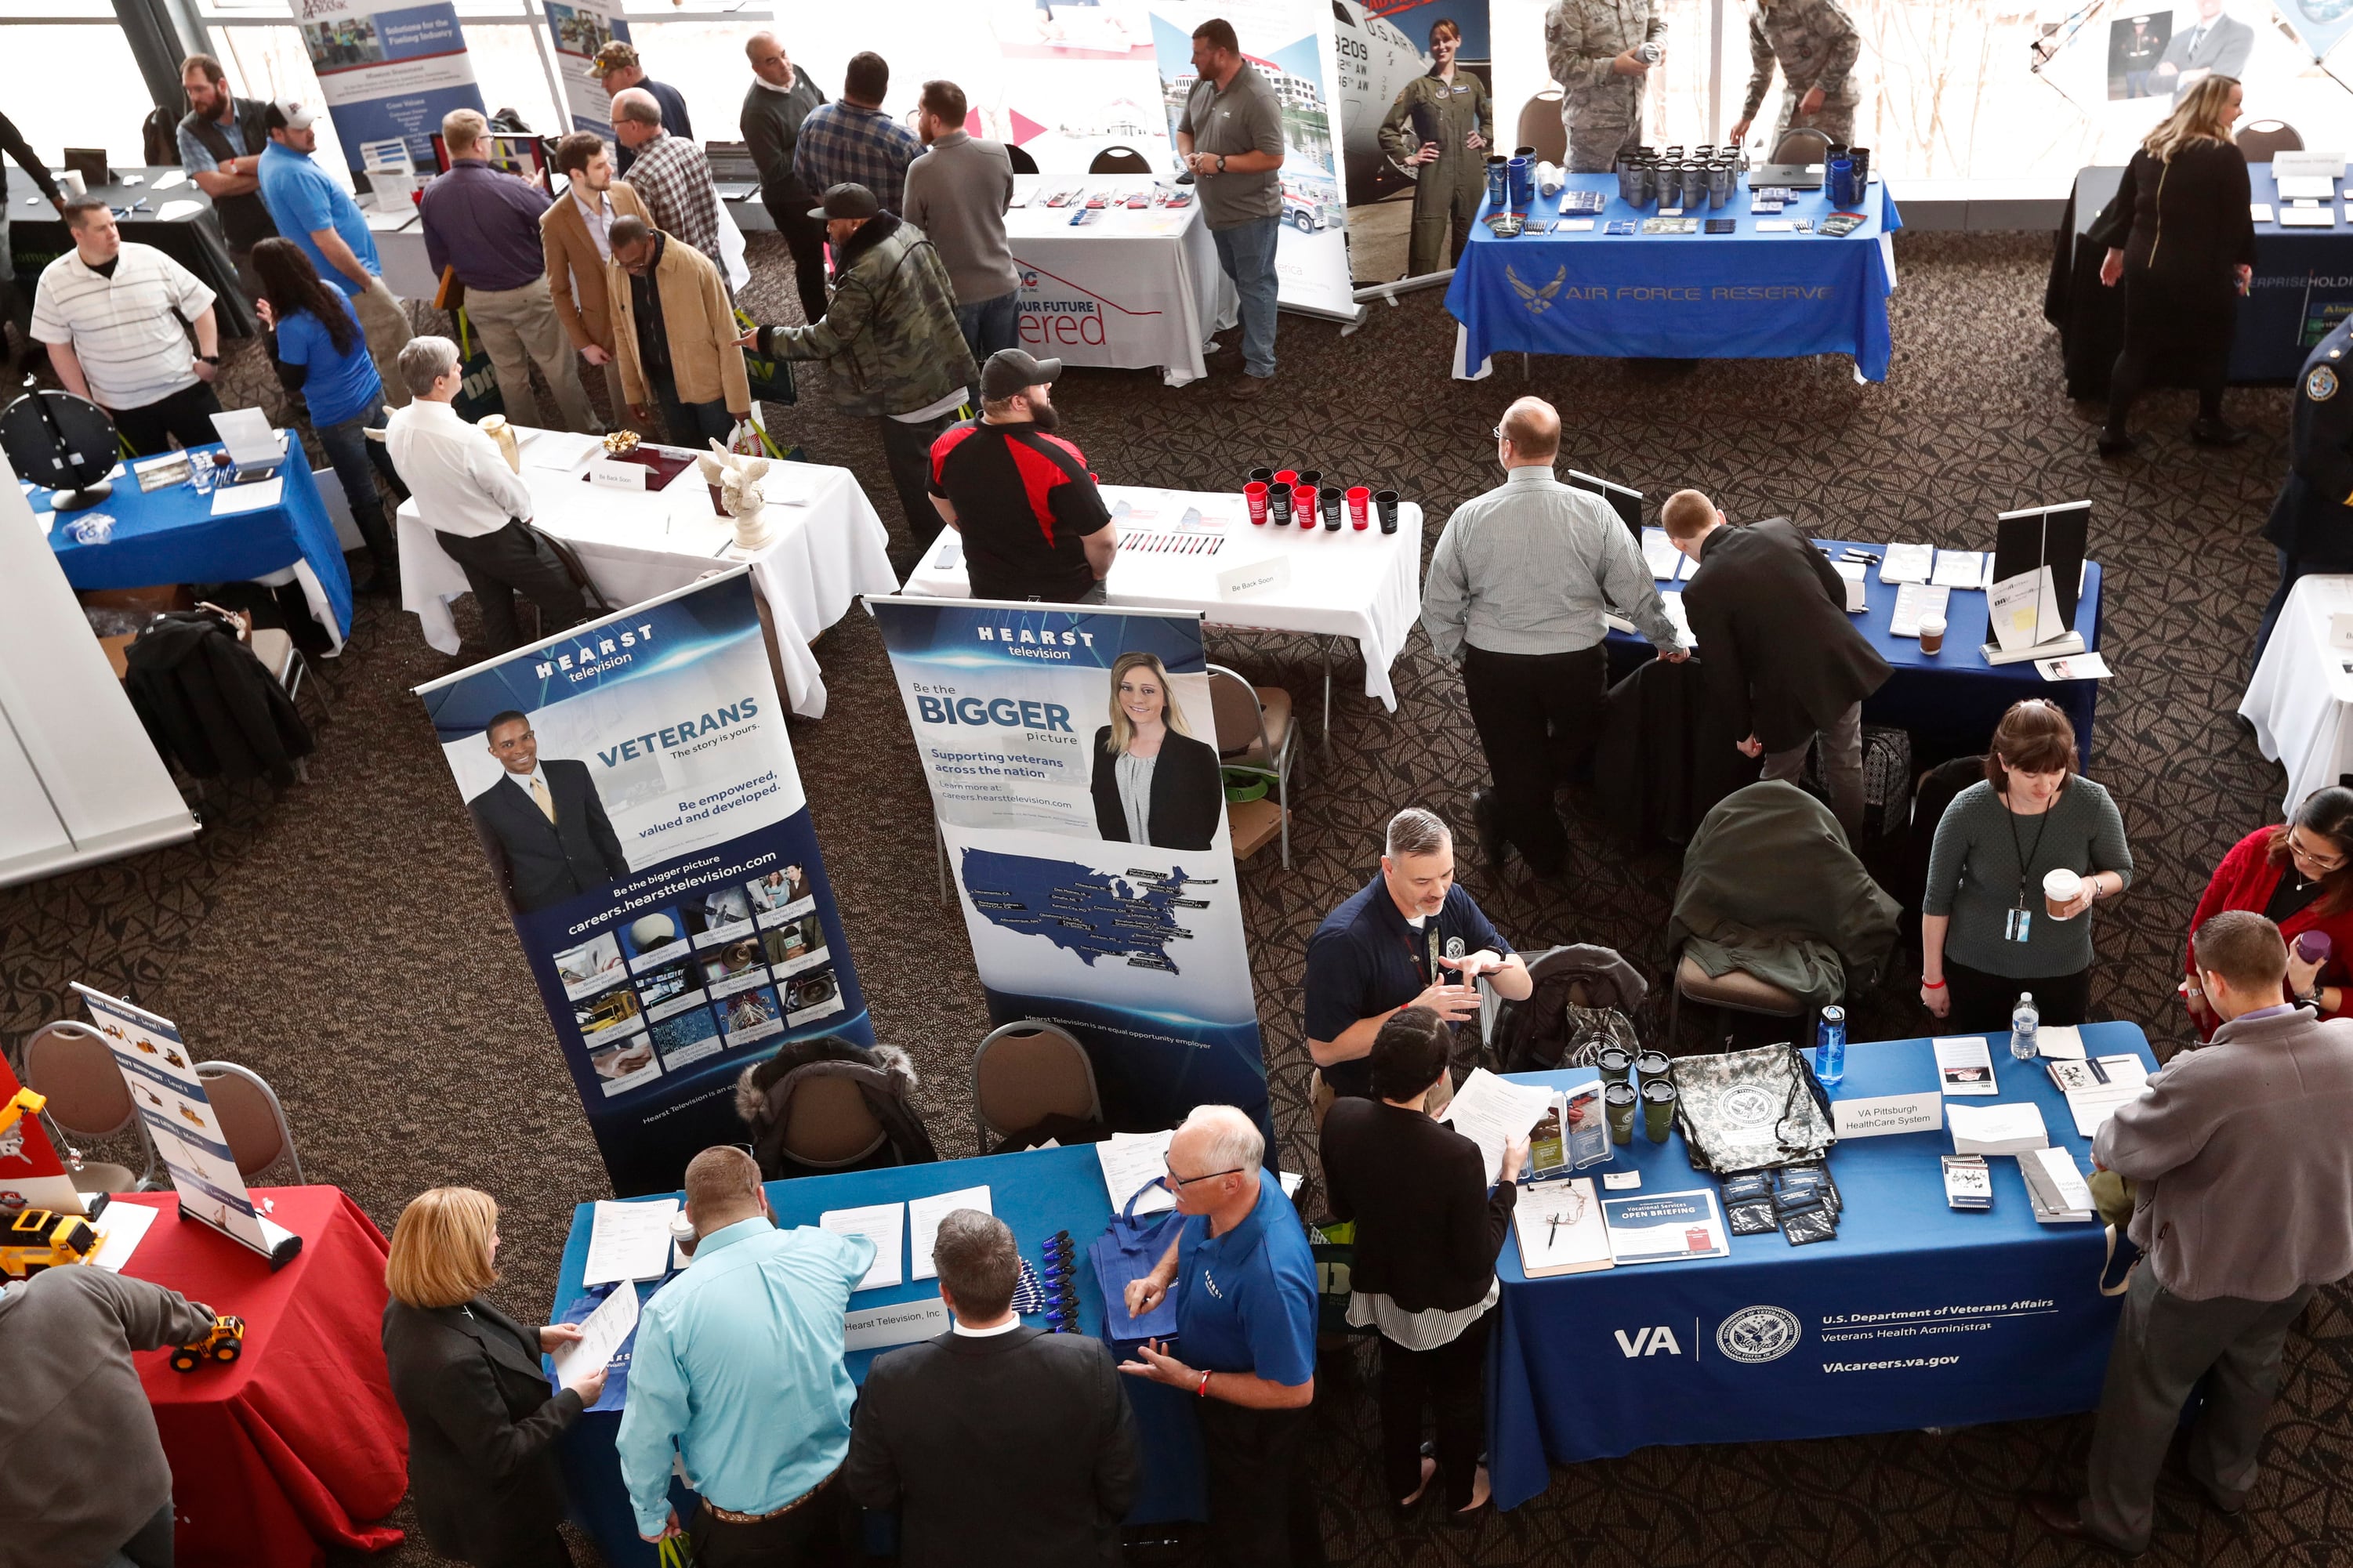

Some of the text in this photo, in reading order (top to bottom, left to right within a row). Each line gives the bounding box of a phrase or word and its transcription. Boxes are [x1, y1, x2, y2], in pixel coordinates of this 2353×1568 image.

[385, 24, 422, 35] Solutions
[435, 19, 449, 27] the
[419, 29, 453, 41] Industry
[1565, 285, 1836, 301] AIR FORCE RESERVE
[1044, 301, 1094, 313] FUTURE
[1242, 580, 1256, 589] Back
[1257, 576, 1274, 585] Soon
[977, 626, 1094, 647] HEARST
[535, 624, 652, 680] HEARST
[1008, 645, 1071, 660] television
[568, 654, 633, 683] television
[913, 682, 956, 695] Be the
[916, 694, 1075, 733] BIGGER
[596, 697, 759, 769] VETERANS
[669, 723, 761, 760] The story is yours.
[1026, 732, 1079, 746] picture
[930, 748, 1064, 769] Supporting veterans
[935, 763, 1046, 780] across the nation
[677, 770, 778, 813] Be empowered,
[939, 780, 964, 791] Learn
[990, 784, 1002, 792] at:
[942, 791, 1073, 809] careers.hearsttelevision.com
[638, 782, 782, 839] valued and developed.
[613, 854, 722, 899] Be the bigger picture
[567, 850, 778, 936] careers.hearsttelevision.com
[140, 1018, 158, 1030] Level
[1024, 1014, 1052, 1023] Hearst
[1052, 1016, 1089, 1028] Television
[1107, 1027, 1129, 1036] equal
[1129, 1030, 1174, 1044] opportunity
[1175, 1037, 1211, 1050] employer
[167, 1078, 184, 1091] Level
[643, 1109, 670, 1125] Hearst
[670, 1093, 709, 1114] Television
[716, 1086, 727, 1095] an
[1858, 1104, 1918, 1117] VA Pittsburgh
[1846, 1115, 1931, 1130] HealthCare System
[1650, 1207, 1696, 1217] BRIEFING
[1205, 1269, 1223, 1299] HEARST
[844, 1309, 943, 1332] Hearst Television, Inc.
[1822, 1298, 2054, 1324] U.S. Department of Veterans Affairs
[1614, 1326, 1682, 1359] VA
[1821, 1331, 1874, 1343] Veterans
[1876, 1327, 1917, 1338] Health
[1822, 1355, 1960, 1374] VAcareers.va.gov
